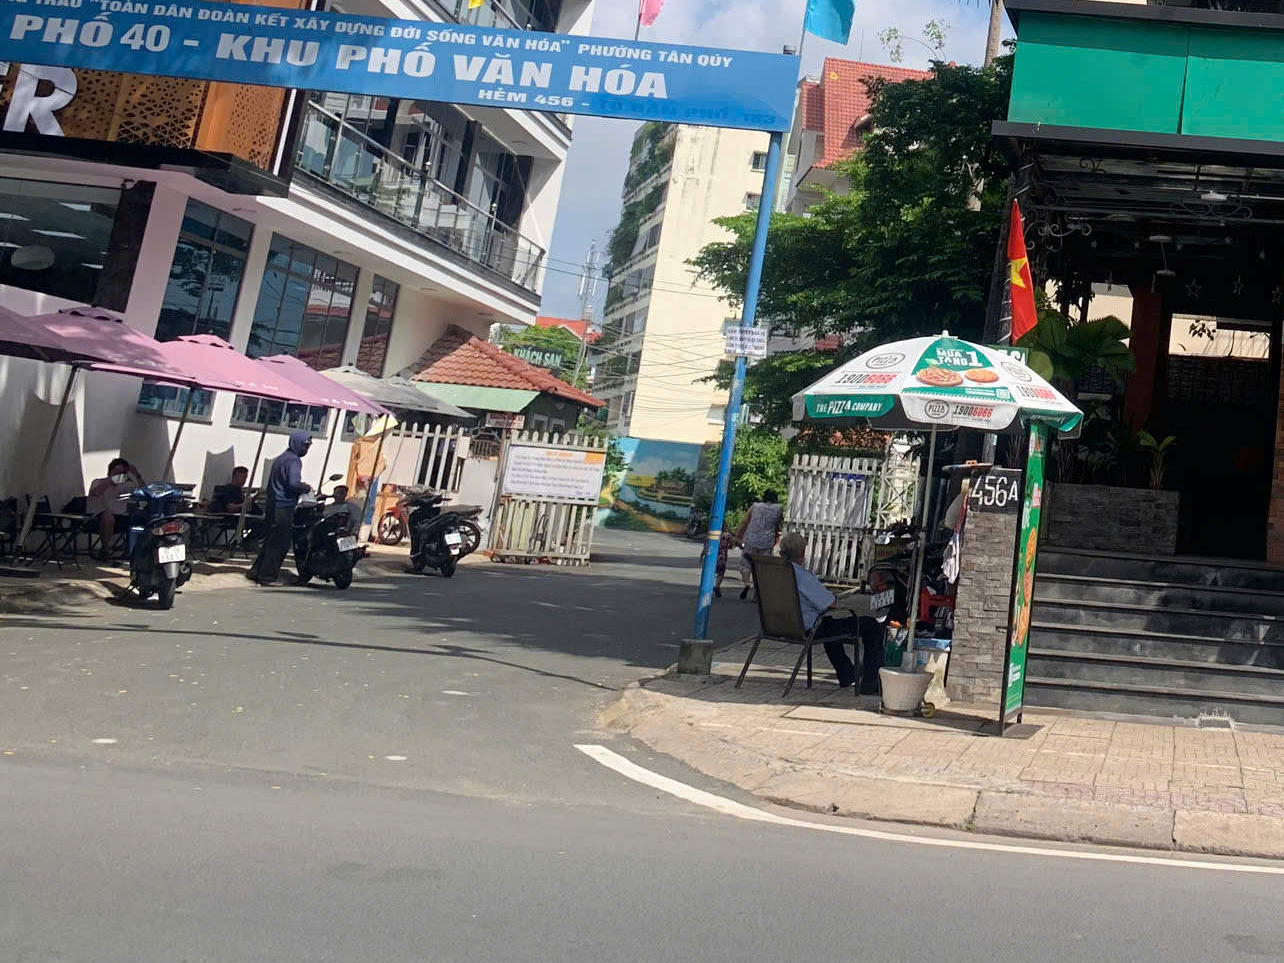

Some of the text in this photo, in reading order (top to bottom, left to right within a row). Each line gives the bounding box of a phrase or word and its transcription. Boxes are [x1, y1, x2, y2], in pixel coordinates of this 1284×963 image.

[153, 3, 192, 18] DÂN
[197, 7, 249, 24] ĐOÀN
[254, 11, 289, 28] KẾT
[294, 15, 330, 32] XÂY
[334, 20, 385, 36] DỰNG
[390, 23, 422, 40] ĐỜI
[426, 25, 476, 46] SỐNG
[482, 31, 520, 49] VĂN
[577, 41, 653, 62] PHƯỜNG
[658, 49, 693, 65] TÂN
[9, 11, 669, 99] PHỐ 40 - KHU PHỐ VĂN HÓA
[478, 88, 527, 104] HẺM
[534, 95, 575, 108] 456
[936, 348, 963, 358] MUA
[816, 400, 883, 414] THE PIZZA COMPANY
[928, 405, 946, 414] PIZZA
[971, 475, 1019, 507] 456A
